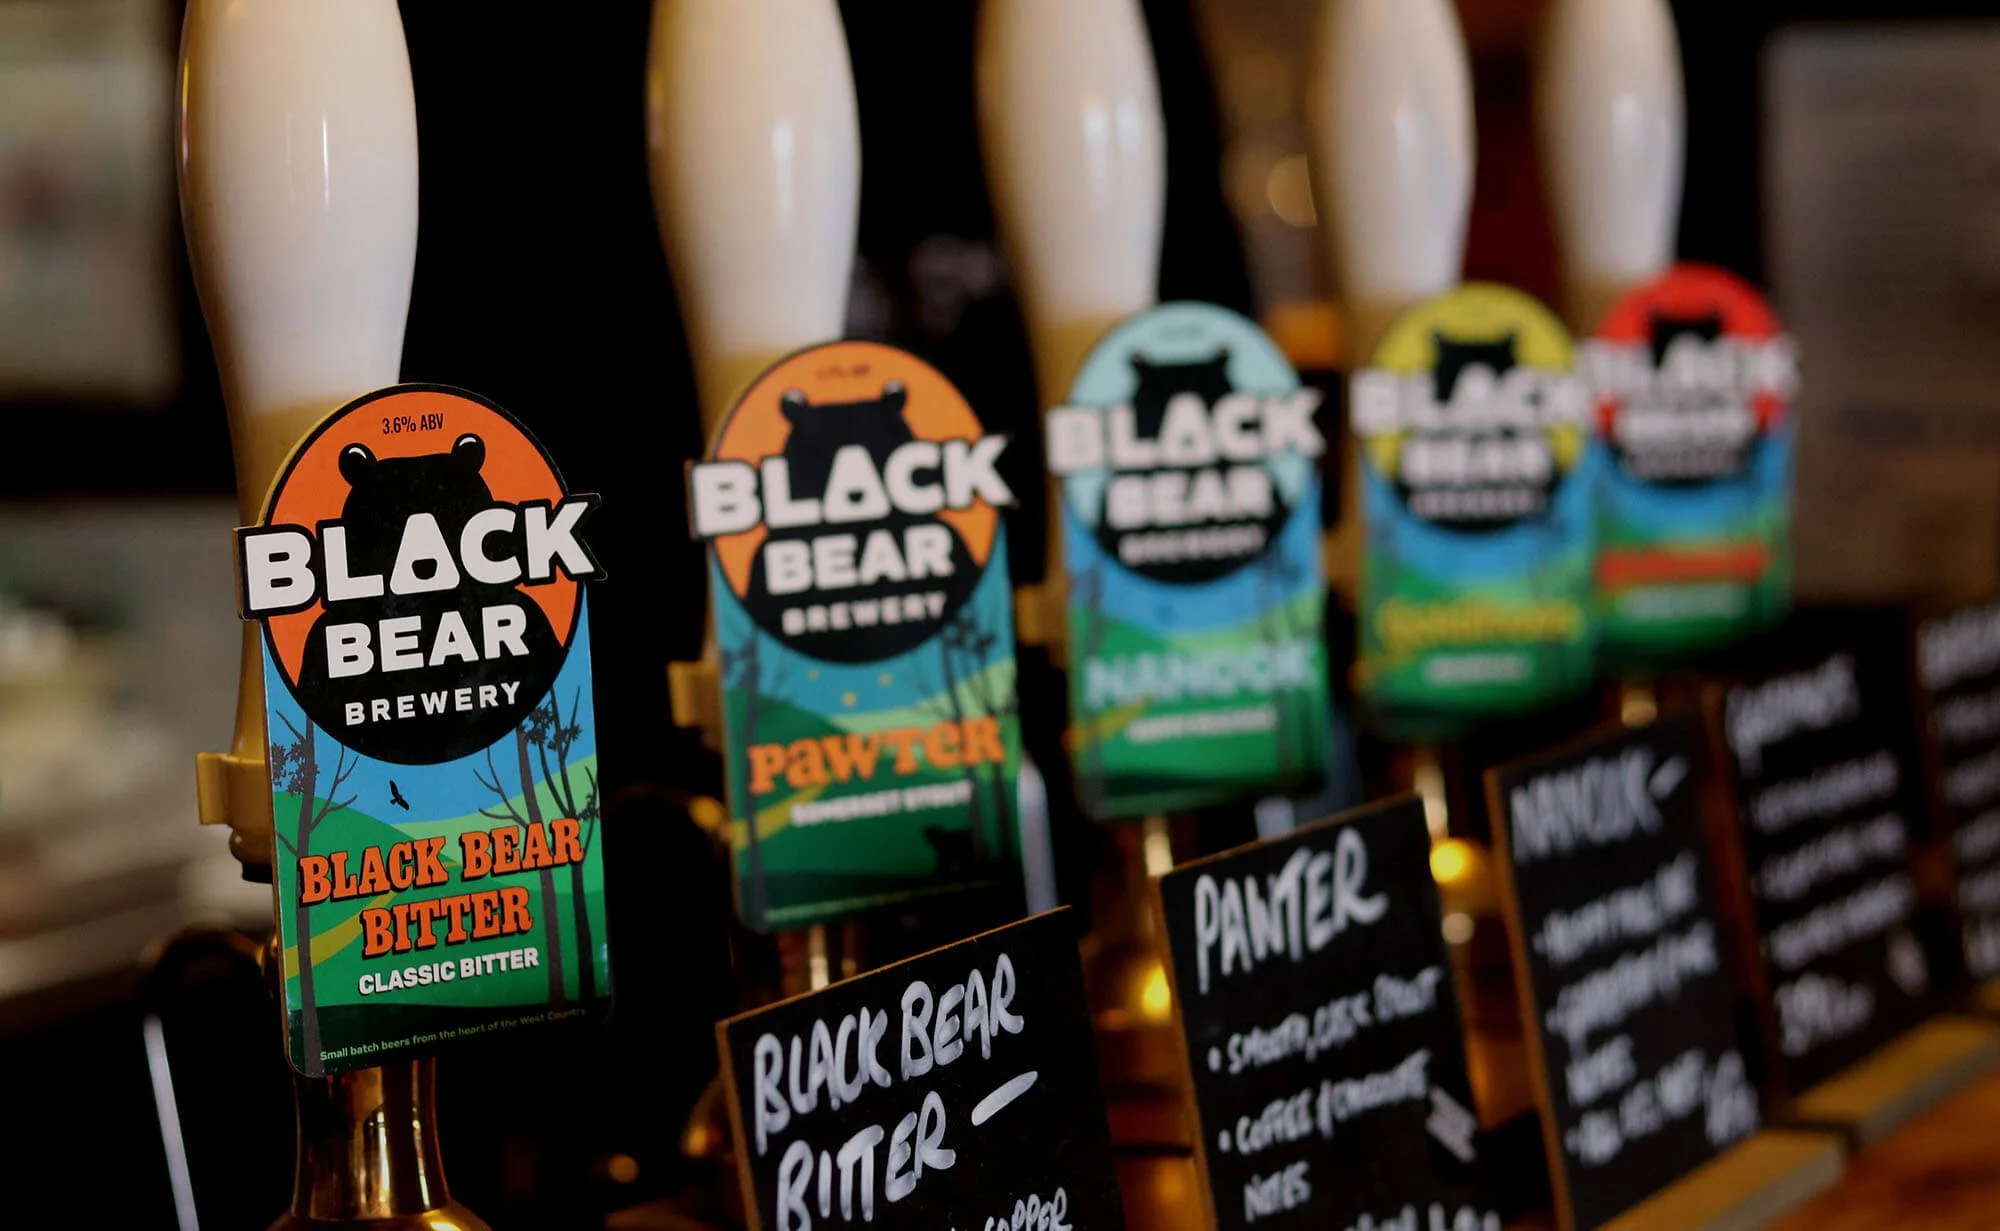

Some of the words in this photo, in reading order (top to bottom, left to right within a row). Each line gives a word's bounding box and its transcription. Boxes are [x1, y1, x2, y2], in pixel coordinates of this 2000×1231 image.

[382, 415, 416, 434] 3.6%
[420, 413, 444, 432] ABV
[1047, 388, 1325, 474] BLACK
[691, 435, 1015, 536] BLACK
[245, 502, 594, 611] BLACK
[764, 523, 954, 595] BEAR
[325, 604, 529, 678] BEAR
[782, 592, 947, 635] BREWERY
[345, 682, 520, 725] BREWERY
[300, 836, 449, 907] BLACK
[460, 818, 584, 881] BEAR
[361, 886, 534, 959] BITTER
[358, 961, 456, 995] CLASSIC
[460, 947, 540, 978] BITTER
[320, 1048, 348, 1061] Small
[350, 1043, 379, 1056] batch
[381, 1037, 410, 1050] beers
[412, 1033, 437, 1044] from
[439, 1029, 456, 1040] the
[458, 1023, 486, 1036] heart
[488, 1021, 499, 1031] of
[501, 1018, 518, 1029] the
[520, 1013, 545, 1025] West
[754, 1006, 892, 1157] BLACK
[901, 952, 1025, 1081] BEAR
[776, 1090, 956, 1231] BITTER
